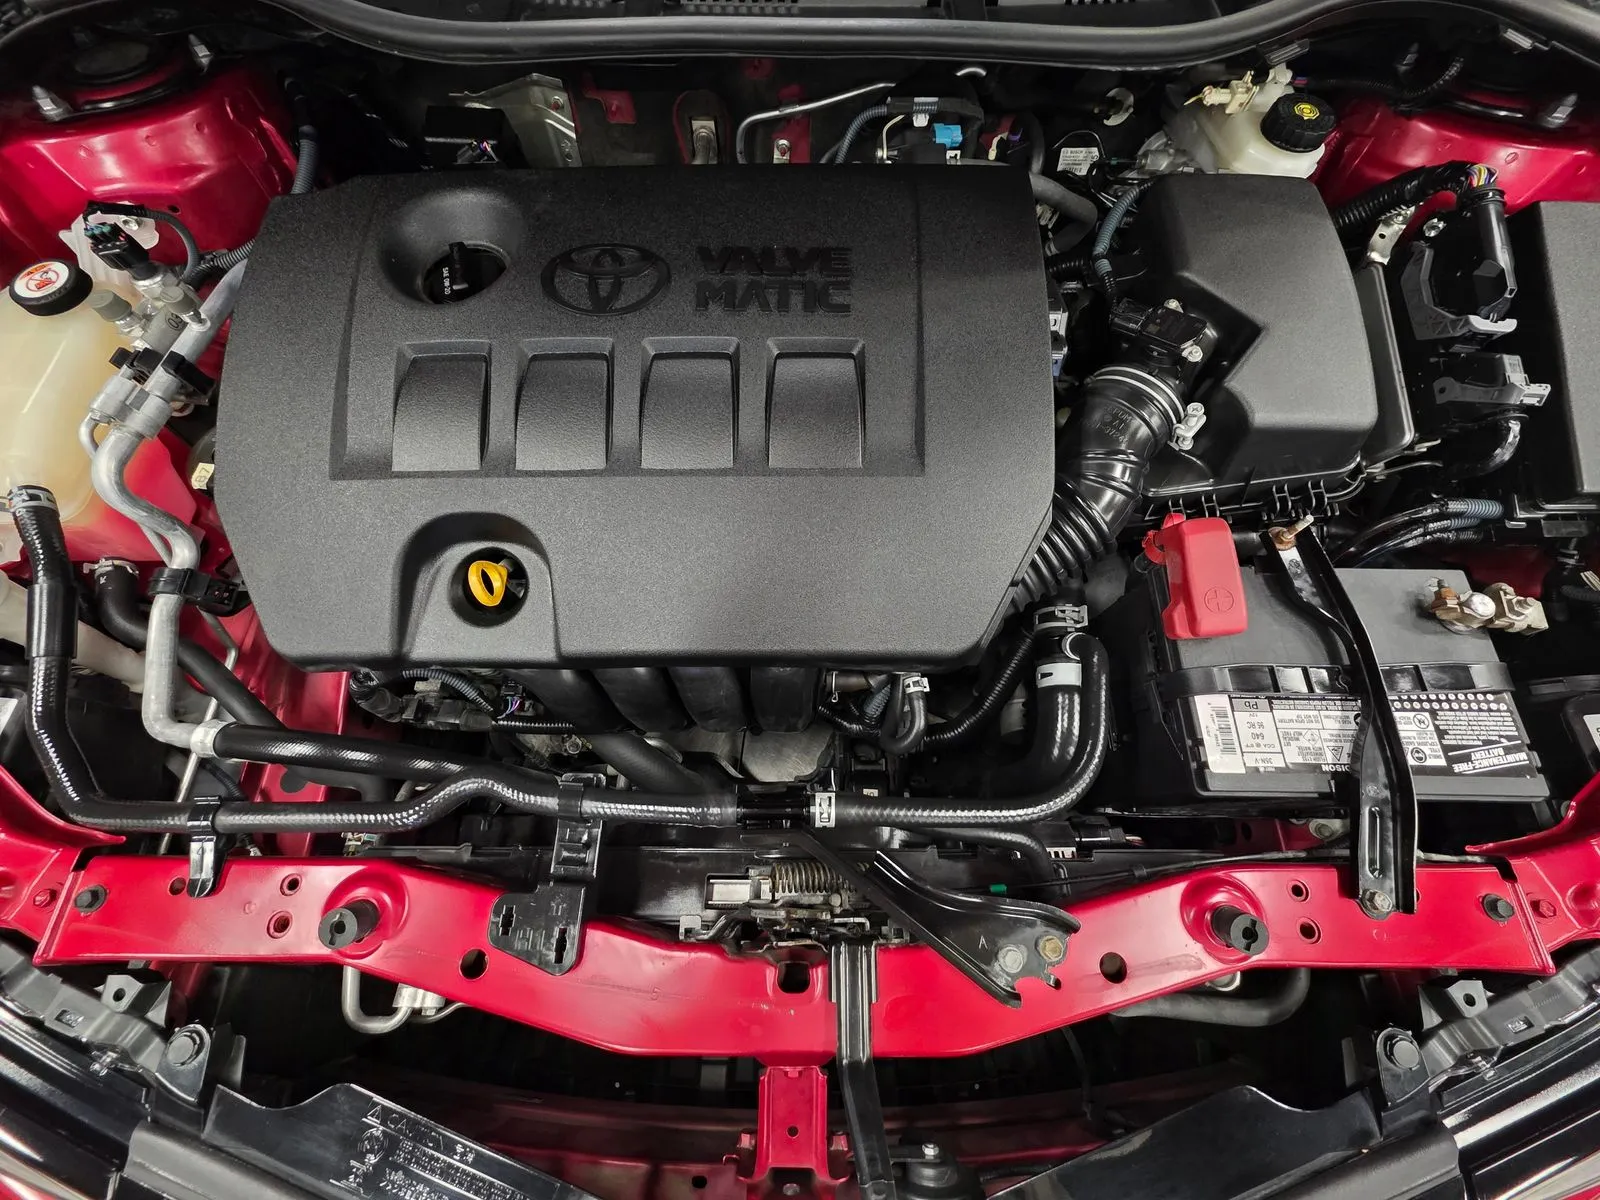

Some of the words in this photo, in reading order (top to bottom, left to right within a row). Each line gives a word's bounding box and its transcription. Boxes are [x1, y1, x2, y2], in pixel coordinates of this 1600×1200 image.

[696, 246, 852, 276] VALVE
[442, 267, 450, 278] SAE
[443, 278, 452, 295] 0W-20
[695, 279, 852, 314] MATIC
[1244, 700, 1258, 710] Pb
[1246, 721, 1256, 729] RC
[1251, 732, 1265, 740] 640
[1470, 747, 1505, 761] BATTERY
[1452, 751, 1529, 773] MAINTENANCE-FREE
[978, 935, 989, 950] A
